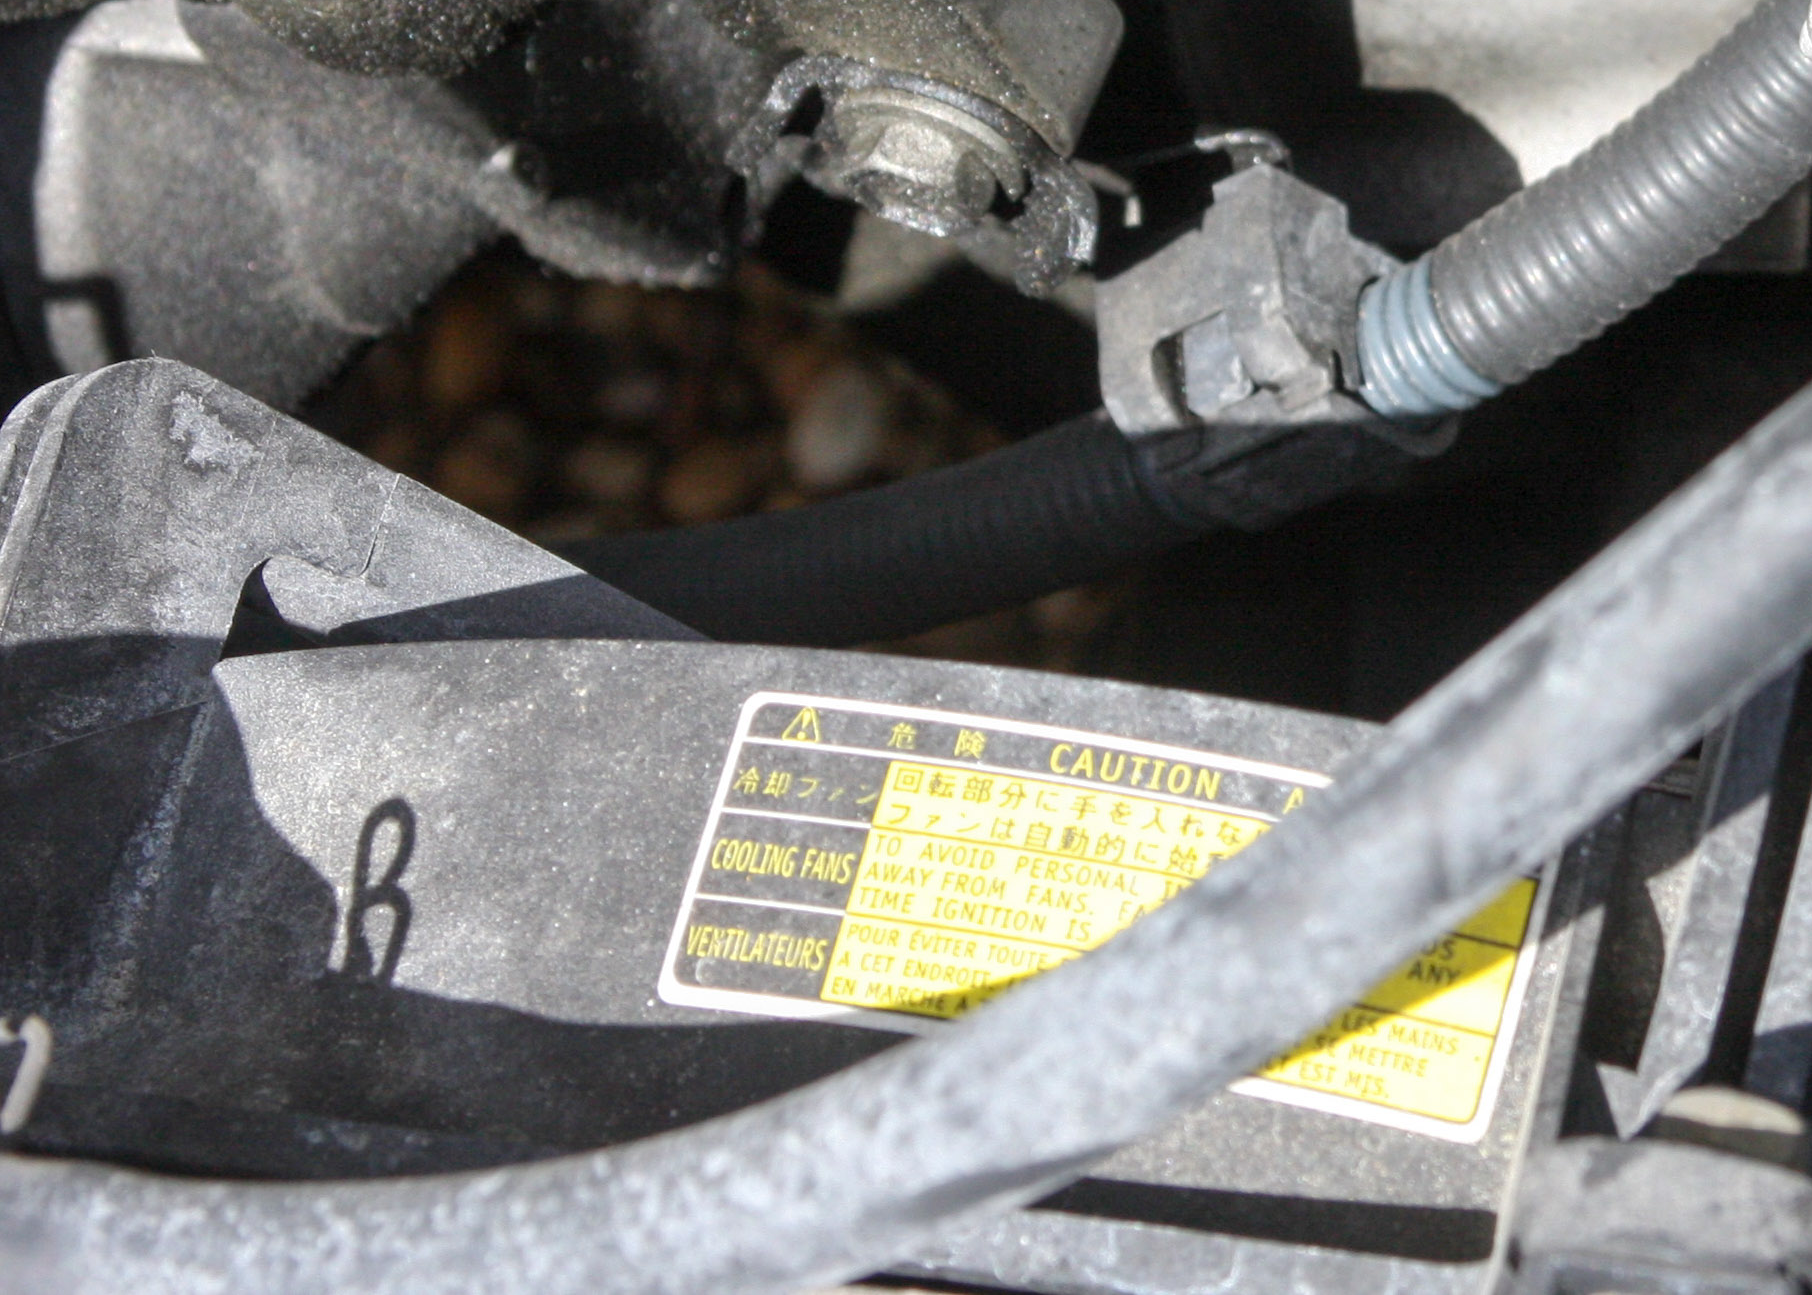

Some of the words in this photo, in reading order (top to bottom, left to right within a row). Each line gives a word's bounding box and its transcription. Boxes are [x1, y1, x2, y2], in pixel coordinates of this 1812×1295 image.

[732, 766, 877, 805] 冷却ファン
[1050, 743, 1222, 801] CAUTION
[893, 767, 1266, 847] 回転部分に手を入れな
[711, 838, 799, 878] COOLING
[800, 847, 857, 885] FANS
[888, 804, 1224, 875] ファンは自動的に始
[864, 861, 933, 888] AWAY
[940, 871, 1007, 900] FROM
[1025, 884, 1095, 915] FANS.
[875, 834, 902, 856] TO
[919, 842, 996, 871] AVOID
[1014, 855, 1139, 897] PERSONAL
[858, 886, 920, 914] TIME
[931, 896, 1047, 934] IGNITION
[1065, 919, 1092, 943] IS
[686, 925, 829, 972] VENTILATEURS
[846, 923, 902, 948] POUR
[909, 929, 977, 960] ÉVITER
[860, 952, 895, 974] CET
[832, 975, 856, 997] EN
[1349, 1042, 1429, 1078] METTRE
[1388, 1023, 1461, 1056] MAINS
[1299, 1059, 1338, 1084] EST
